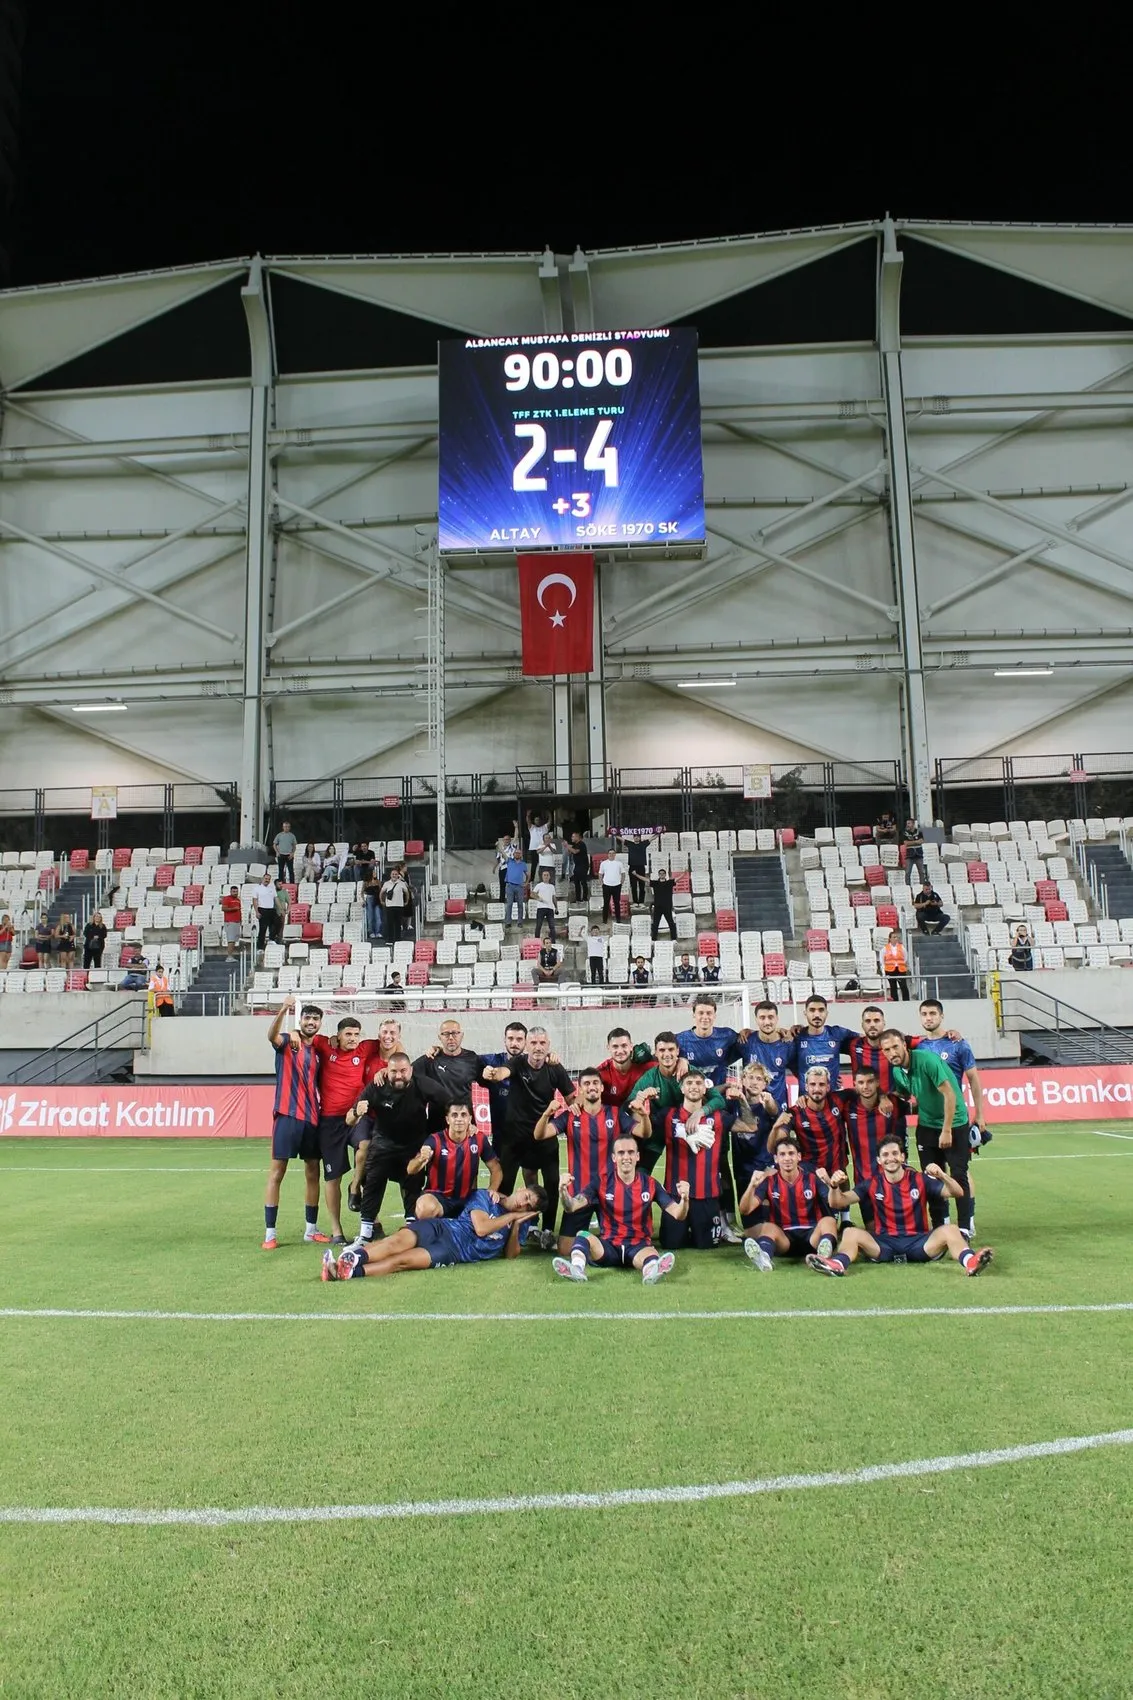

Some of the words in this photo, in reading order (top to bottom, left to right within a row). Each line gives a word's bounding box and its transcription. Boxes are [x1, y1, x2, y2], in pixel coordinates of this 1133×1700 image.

[465, 337, 519, 348] ALSANCAK
[521, 335, 569, 346] MUSTAFA
[571, 331, 612, 343] DENİZLİ
[614, 329, 670, 341] STADYUMU
[503, 348, 633, 392] 90:00
[512, 411, 531, 419] TFF
[533, 409, 552, 418] ZTK
[554, 408, 595, 417] 1.ELEME
[597, 407, 625, 416] TURU
[552, 493, 592, 518] +3
[490, 527, 541, 540] ALTAY
[576, 524, 617, 537] SÖKE
[622, 524, 654, 536] 1970
[658, 522, 678, 534] SK
[961, 1082, 1037, 1107] iaat
[1042, 1079, 1133, 1104] Banka
[18, 1100, 110, 1127] Ziraat
[115, 1100, 215, 1127] Katılım
[711, 1226, 722, 1239] 19
